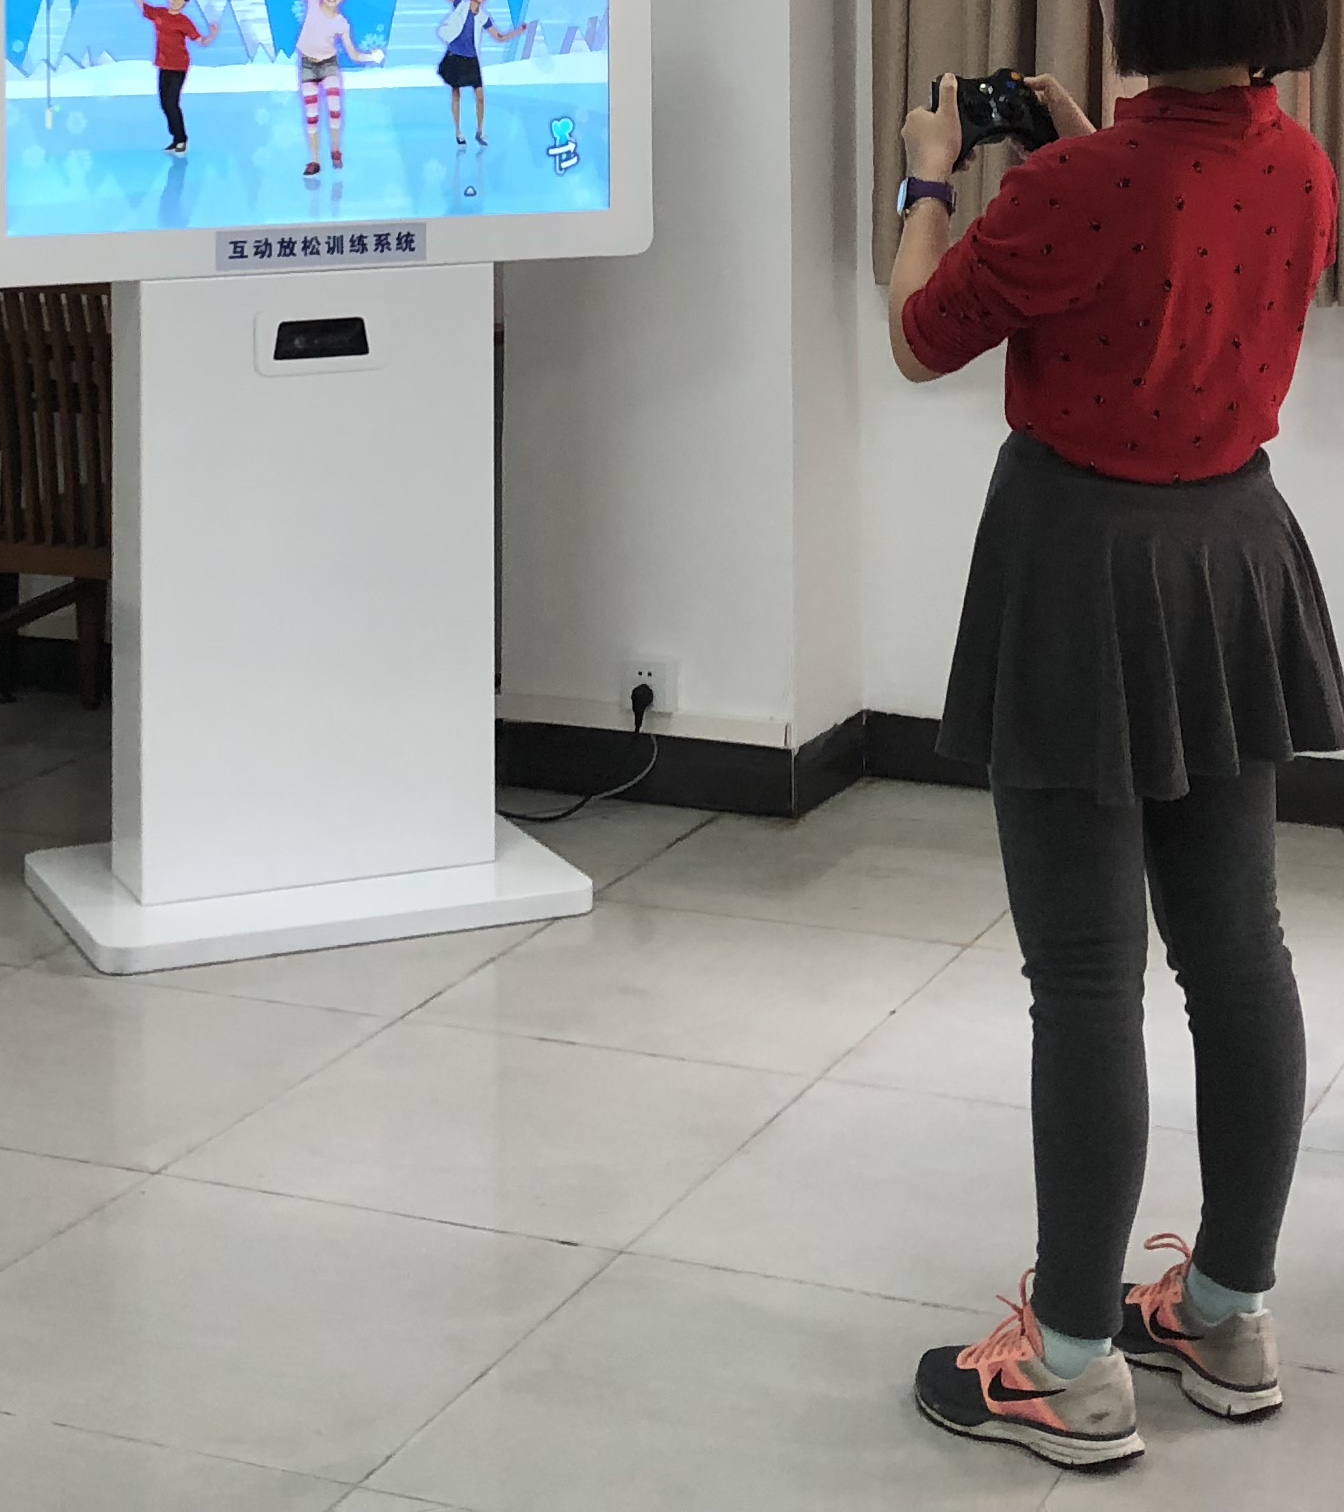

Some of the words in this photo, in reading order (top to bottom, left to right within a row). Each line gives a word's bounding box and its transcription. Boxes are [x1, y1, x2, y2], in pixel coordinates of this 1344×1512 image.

[228, 231, 416, 259] 互动放松训练系统
